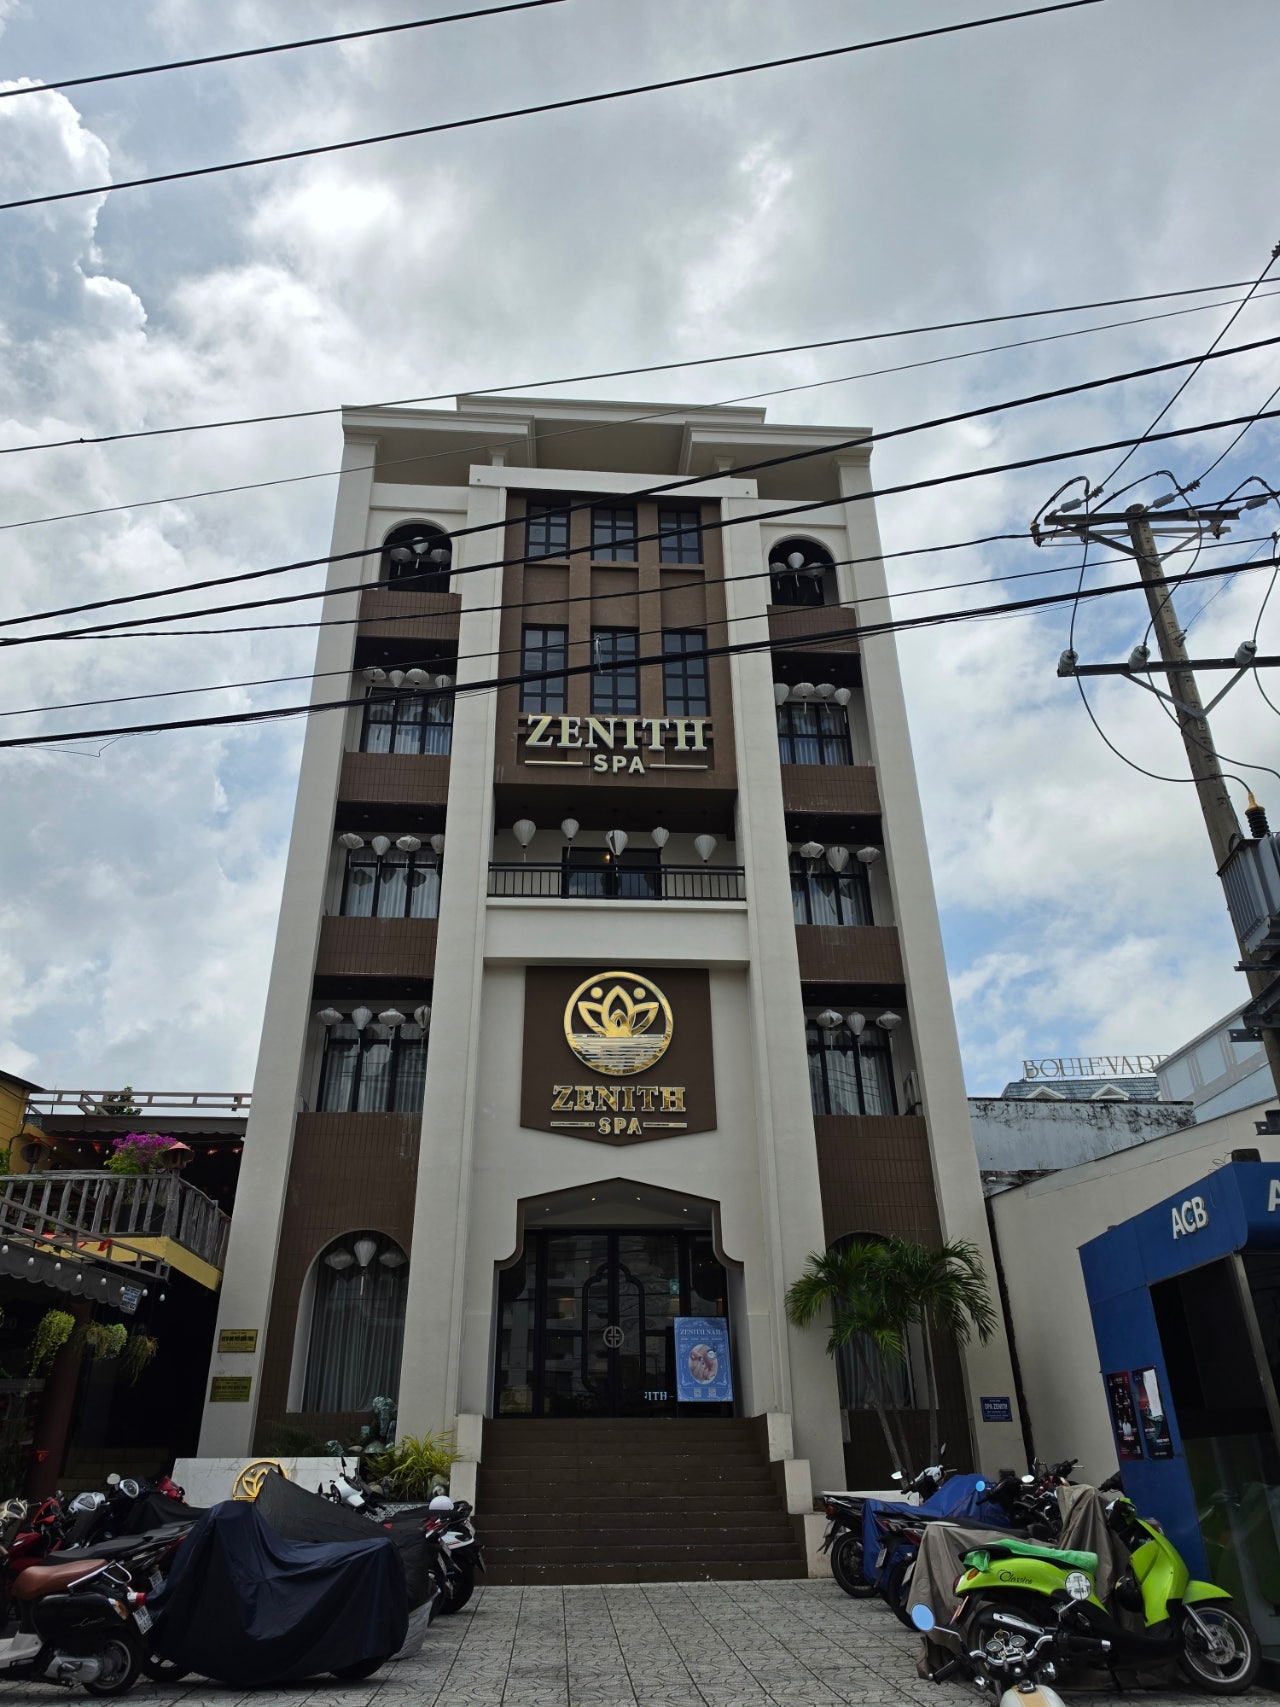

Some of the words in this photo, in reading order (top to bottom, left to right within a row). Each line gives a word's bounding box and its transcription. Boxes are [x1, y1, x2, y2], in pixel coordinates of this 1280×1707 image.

[525, 714, 708, 751] ZENITH
[593, 754, 645, 775] SPA
[551, 1084, 687, 1112] ZENITH
[597, 1116, 642, 1135] SPA
[1171, 1195, 1210, 1240] ACB
